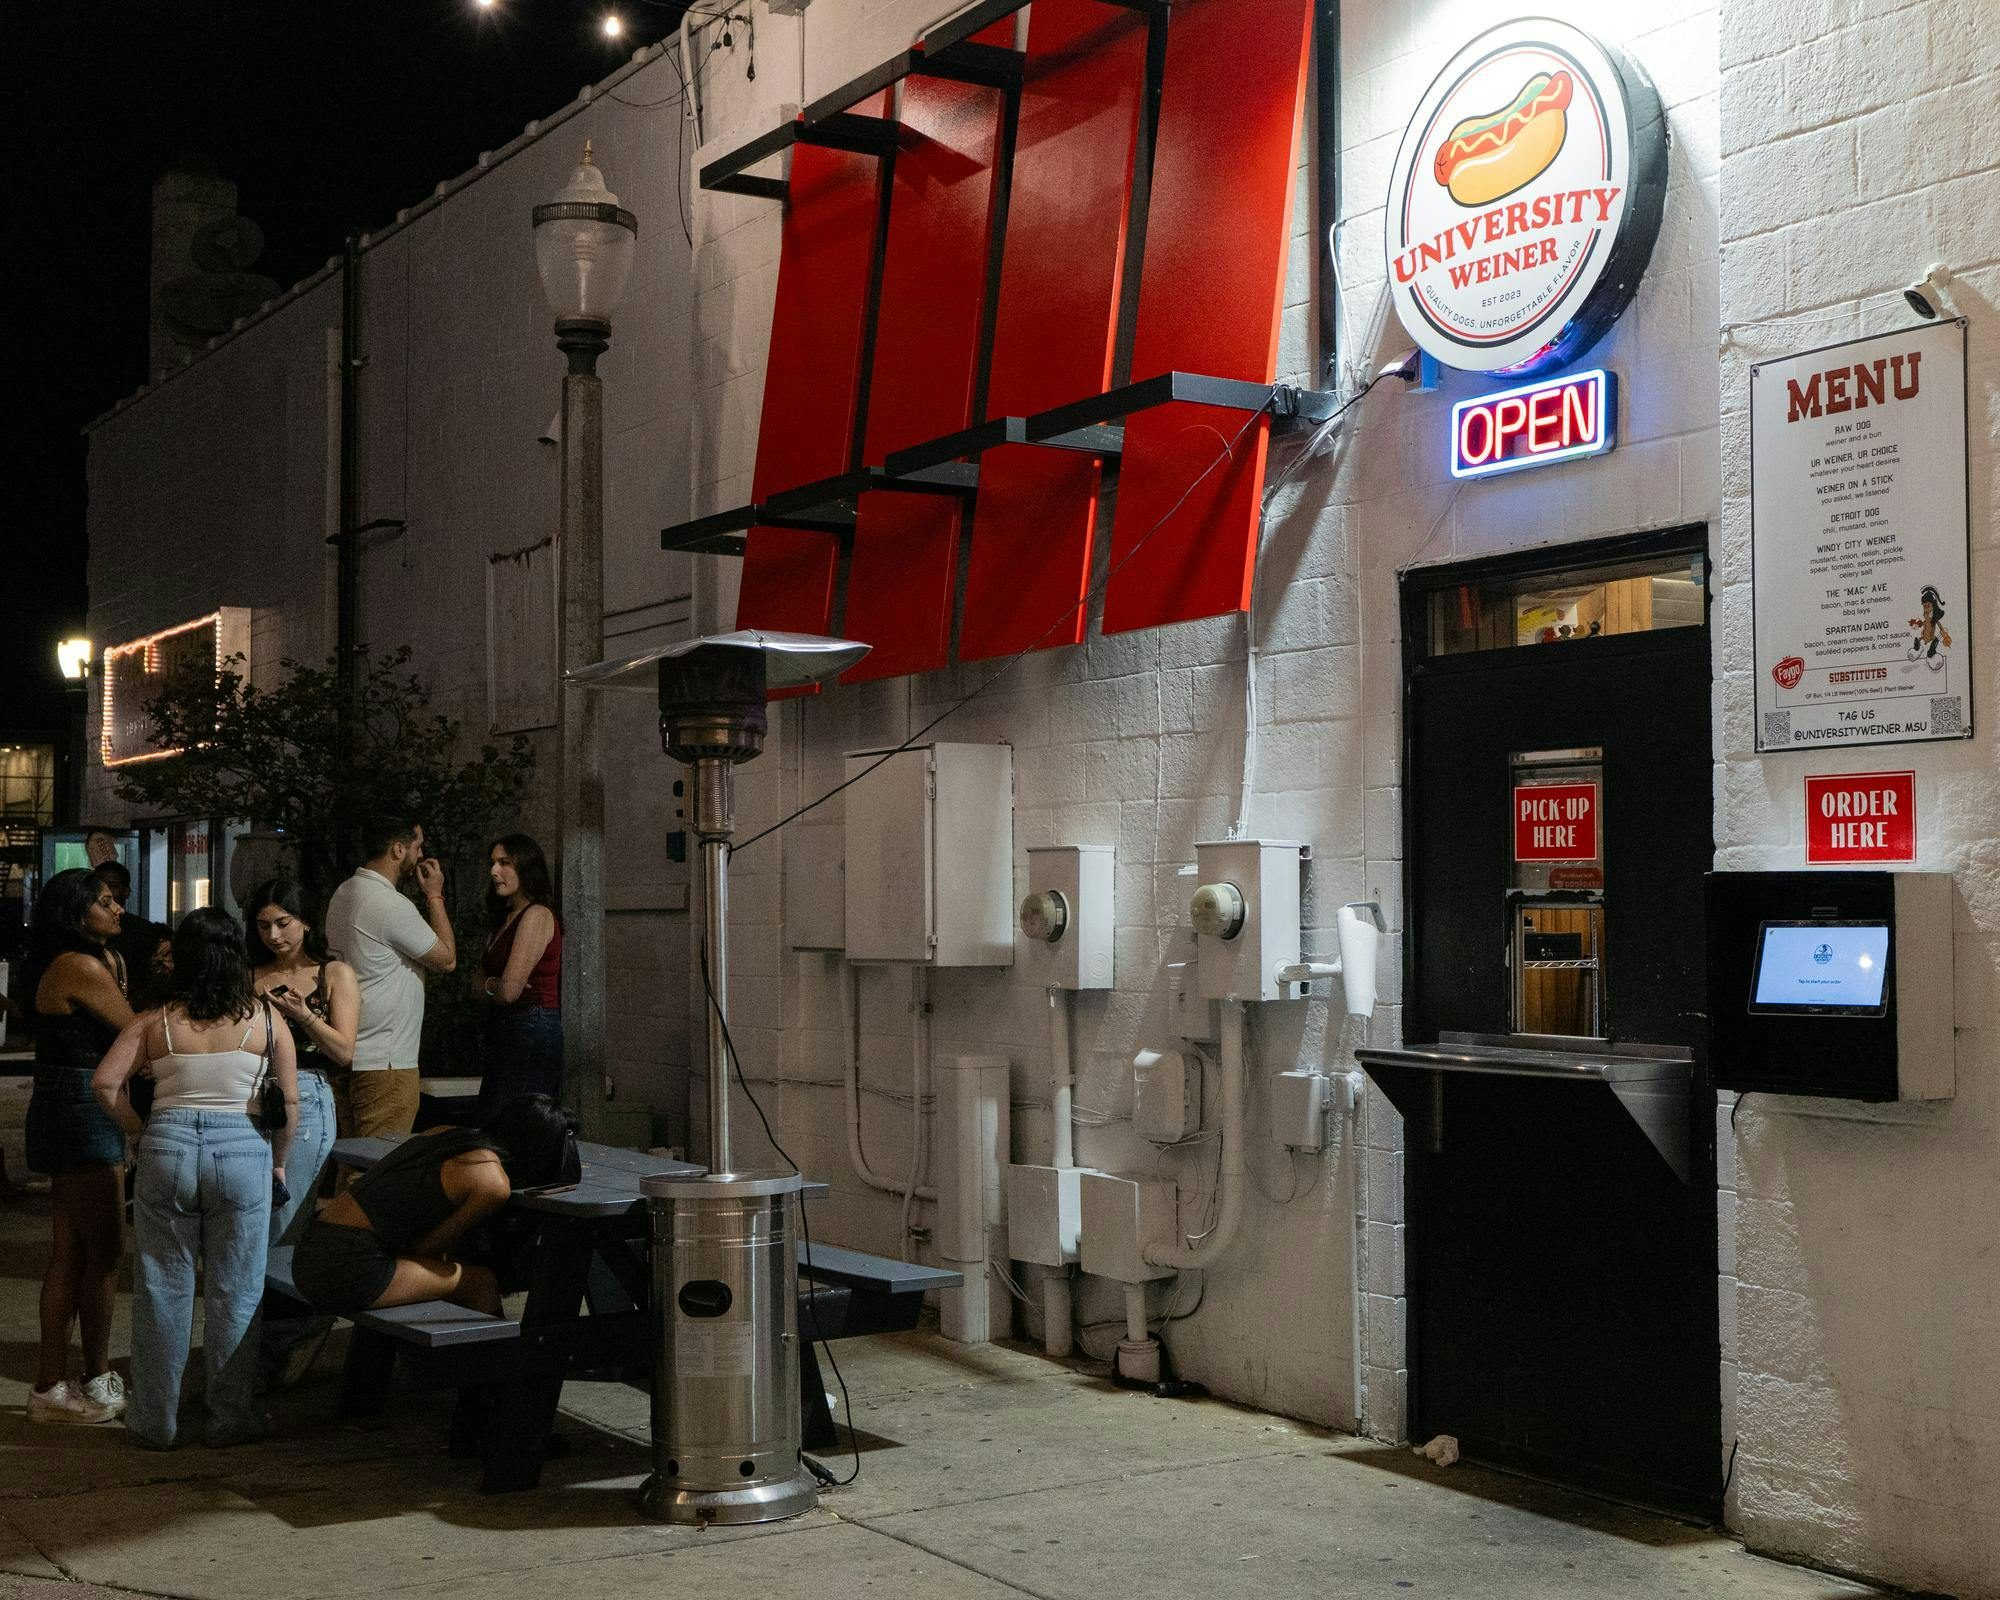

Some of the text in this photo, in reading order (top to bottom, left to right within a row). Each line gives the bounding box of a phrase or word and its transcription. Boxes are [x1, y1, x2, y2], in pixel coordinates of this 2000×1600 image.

[1392, 187, 1621, 283] UNIVERSITY
[1448, 237, 1559, 290] WEINER
[1426, 284, 1452, 318] QUALITY
[1480, 284, 1553, 329] UNFORGETTABLE
[1553, 240, 1581, 285] FLAVOR
[1481, 290, 1522, 308] EST 2023
[1787, 351, 1922, 423] MENU
[1460, 380, 1596, 465] OPEN
[1834, 420, 1871, 434] RAW DOG
[1825, 437, 1847, 447] weiner
[1848, 433, 1861, 442] and
[1868, 431, 1882, 439] bun
[1810, 459, 1821, 468] UR
[1857, 450, 1868, 459] UR
[1871, 444, 1898, 457] CHOICE
[1809, 457, 1901, 478] whatever your heart desires
[1816, 483, 1845, 495] WEINER
[1848, 480, 1859, 489] ON
[1871, 473, 1894, 486] STICK
[1820, 497, 1832, 506] you
[1865, 487, 1889, 497] listened
[1830, 507, 1880, 523] DETROIT DOG
[1869, 519, 1889, 527] onion
[1816, 534, 1896, 554] WINDY CITY WEINER
[1883, 546, 1904, 556] pickle
[1857, 559, 1874, 568] sport
[1839, 571, 1859, 579] celery
[1825, 582, 1888, 598] THE "MAC" AVE
[1842, 607, 1871, 616] bbq lays
[1825, 620, 1889, 636] SPARTAN DAWG
[1827, 637, 1848, 646] cream
[1877, 632, 1888, 640] hot
[1842, 644, 1870, 654] peppers
[1877, 641, 1901, 649] onions
[1777, 664, 1800, 681] Faygo
[1829, 667, 1887, 683] SUBSTITUTES
[1838, 709, 1875, 721] TAG US
[1794, 721, 1928, 741] @UNIVERSITYWEINER.MSU
[1521, 797, 1590, 822] PICK-UP
[1821, 789, 1898, 818] ORDER
[1533, 825, 1577, 848] HERE
[1831, 821, 1889, 848] HERE
